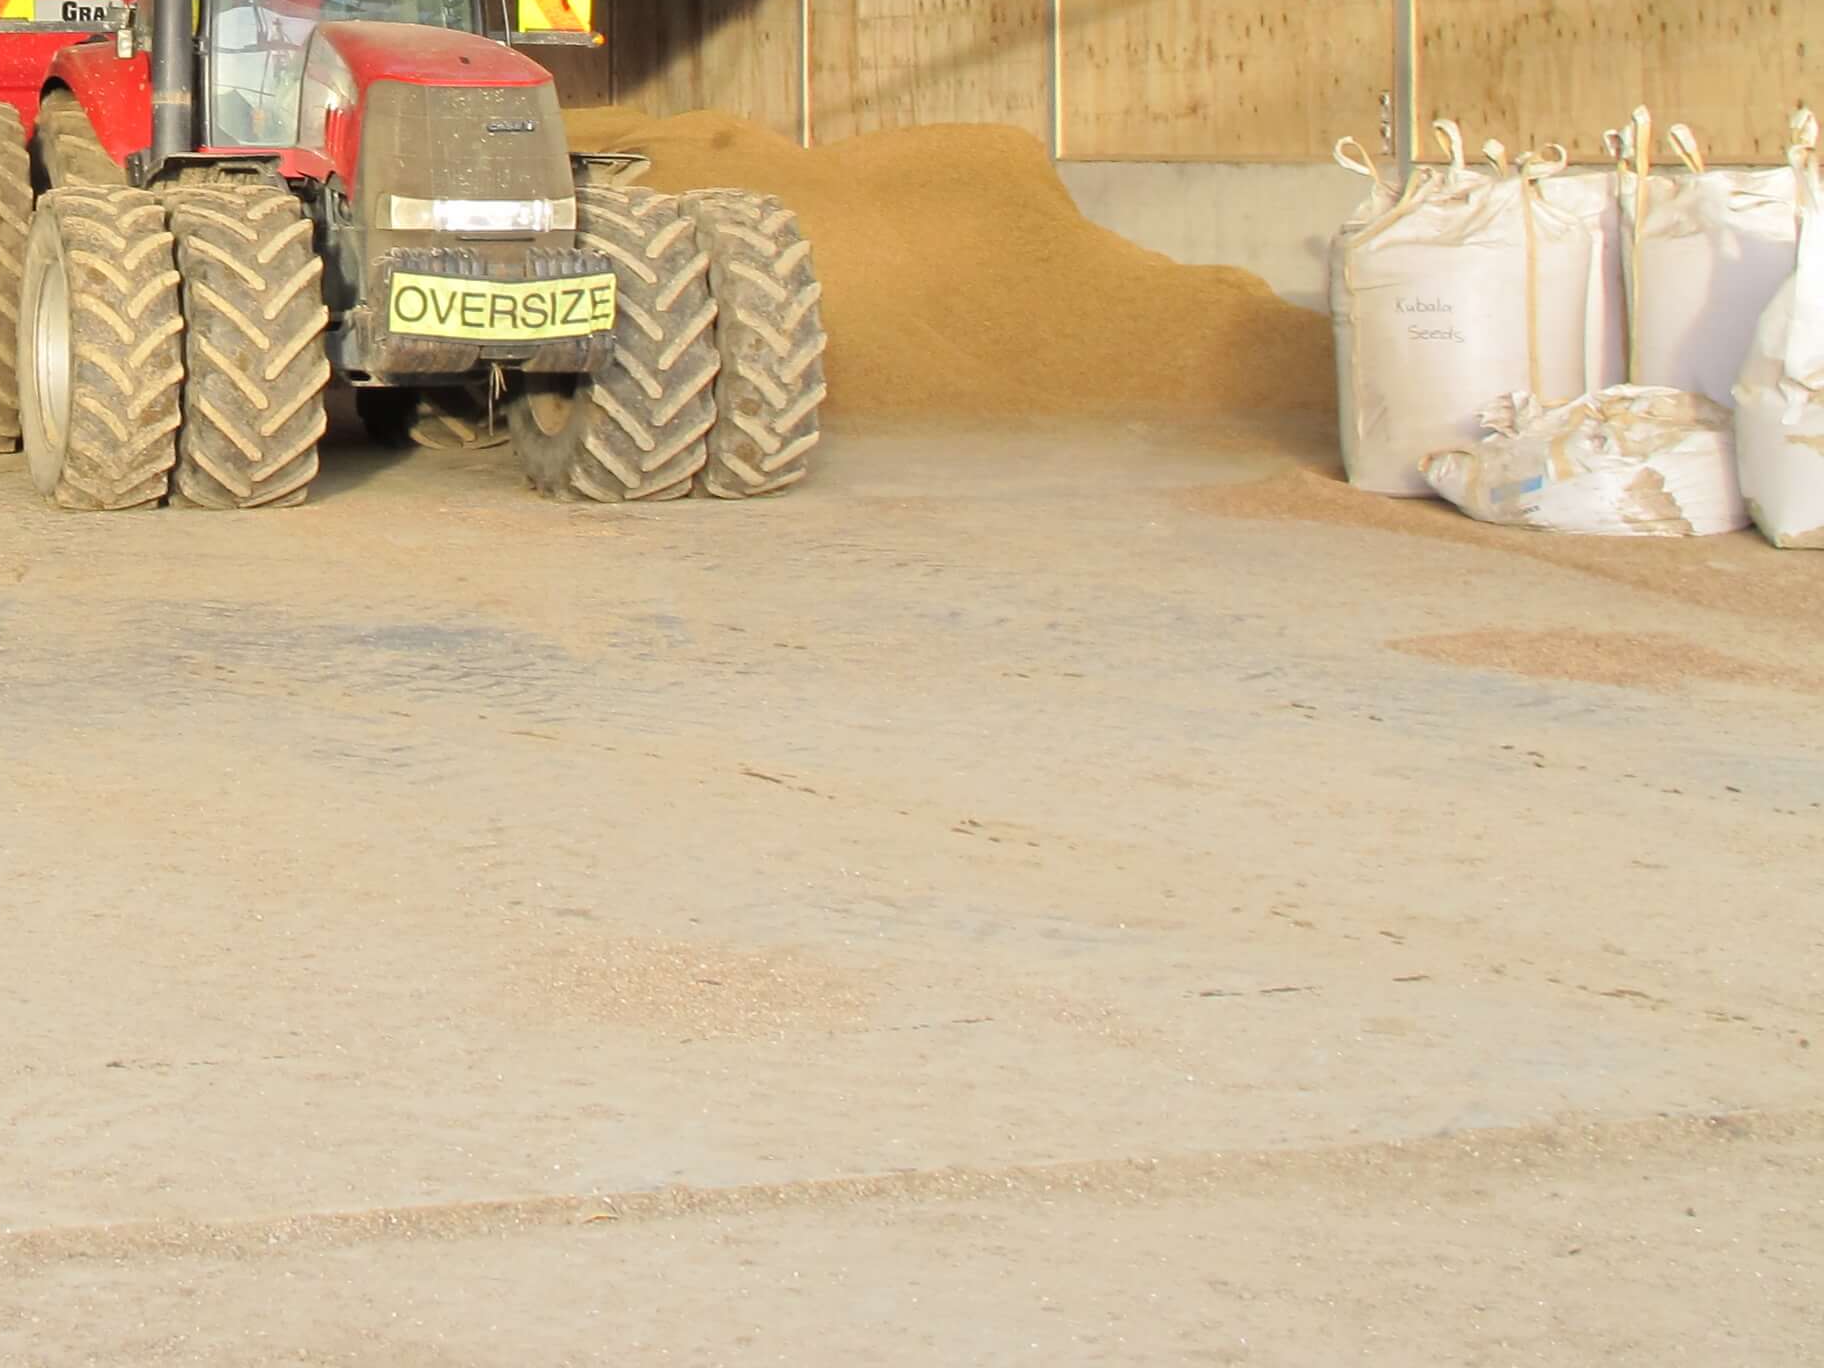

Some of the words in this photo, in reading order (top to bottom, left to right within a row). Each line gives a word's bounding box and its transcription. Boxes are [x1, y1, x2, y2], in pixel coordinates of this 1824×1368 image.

[62, 1, 106, 22] GRA
[394, 285, 612, 329] OVERSIZE
[1407, 324, 1465, 344] Seeds
